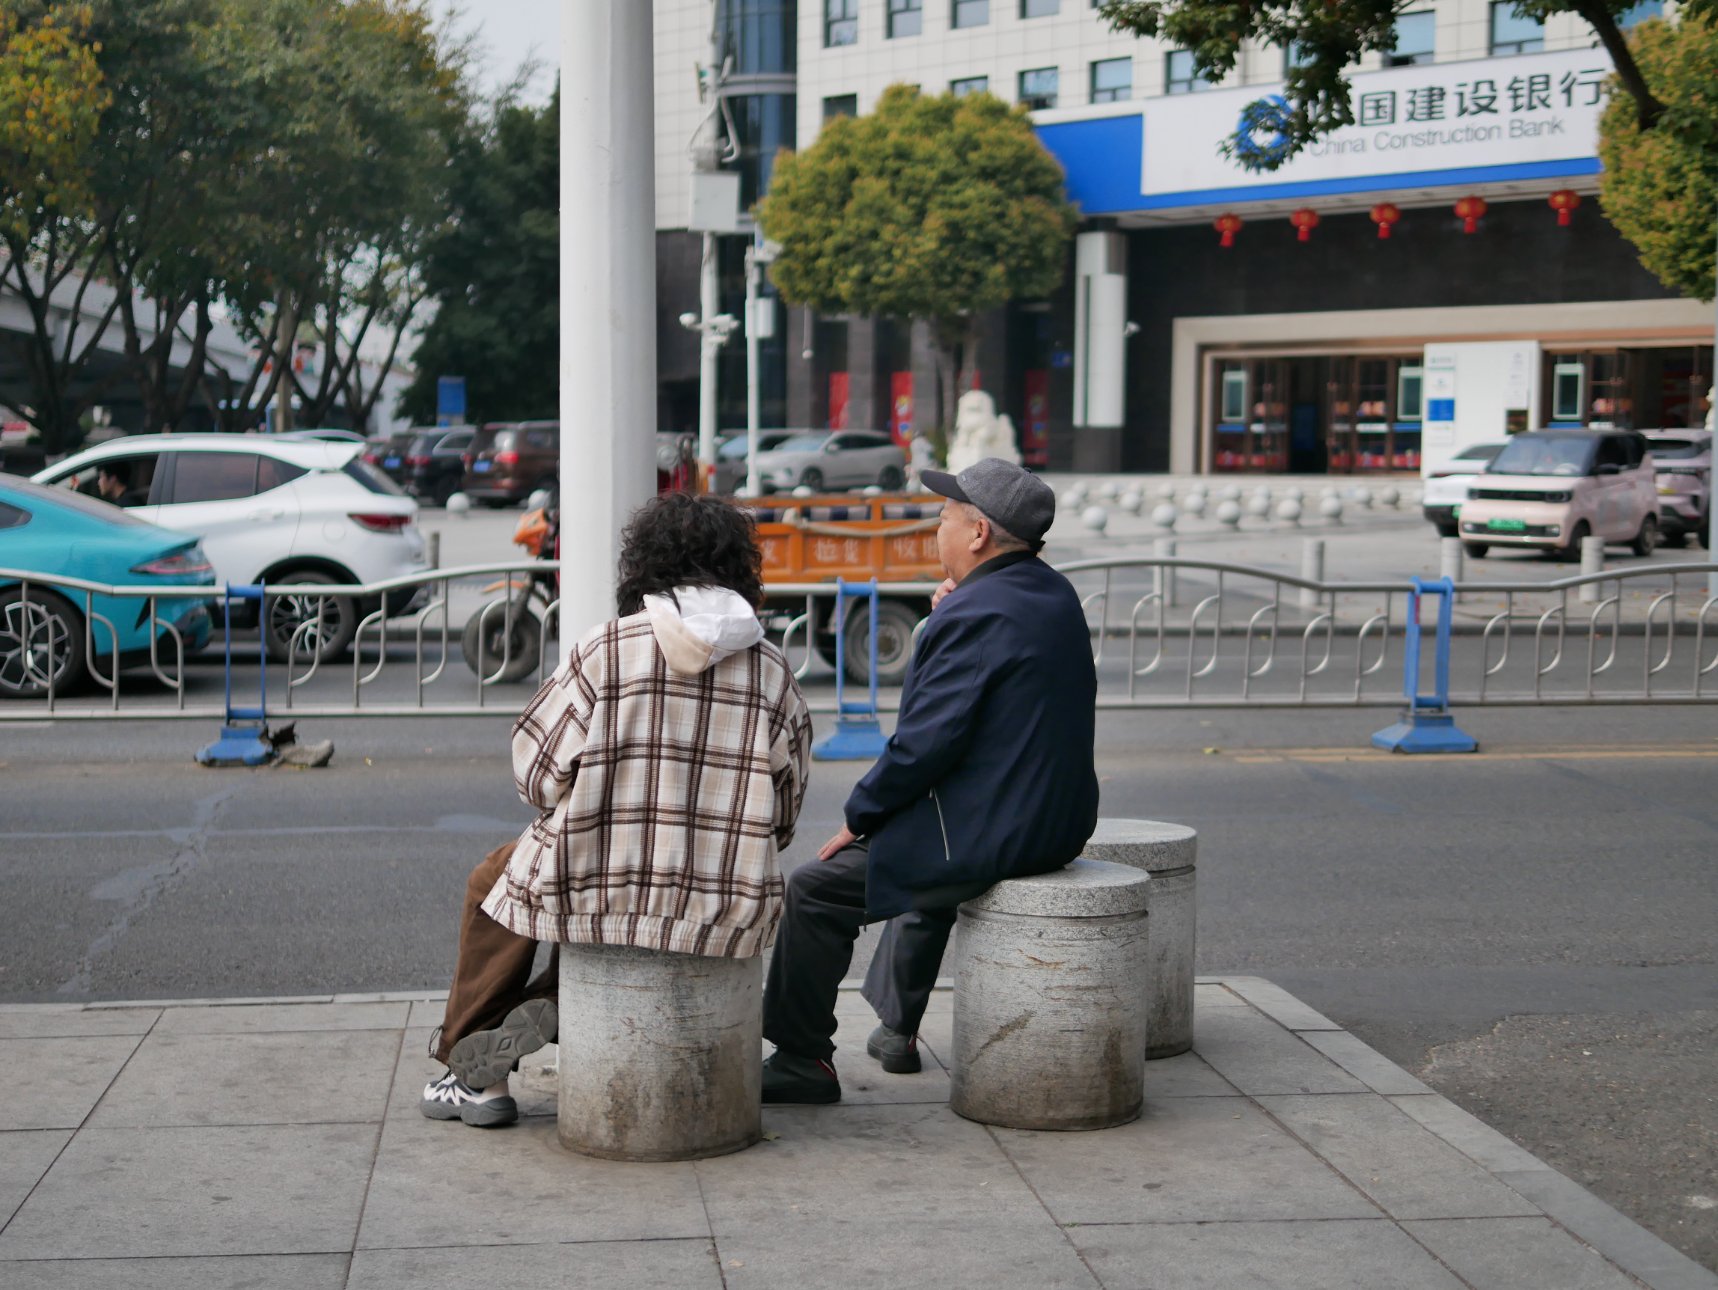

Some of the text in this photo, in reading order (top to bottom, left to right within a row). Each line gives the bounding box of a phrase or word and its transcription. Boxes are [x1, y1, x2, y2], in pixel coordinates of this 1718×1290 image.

[1317, 68, 1605, 128] 国建设银行
[1310, 117, 1565, 157] China Construction Bank
